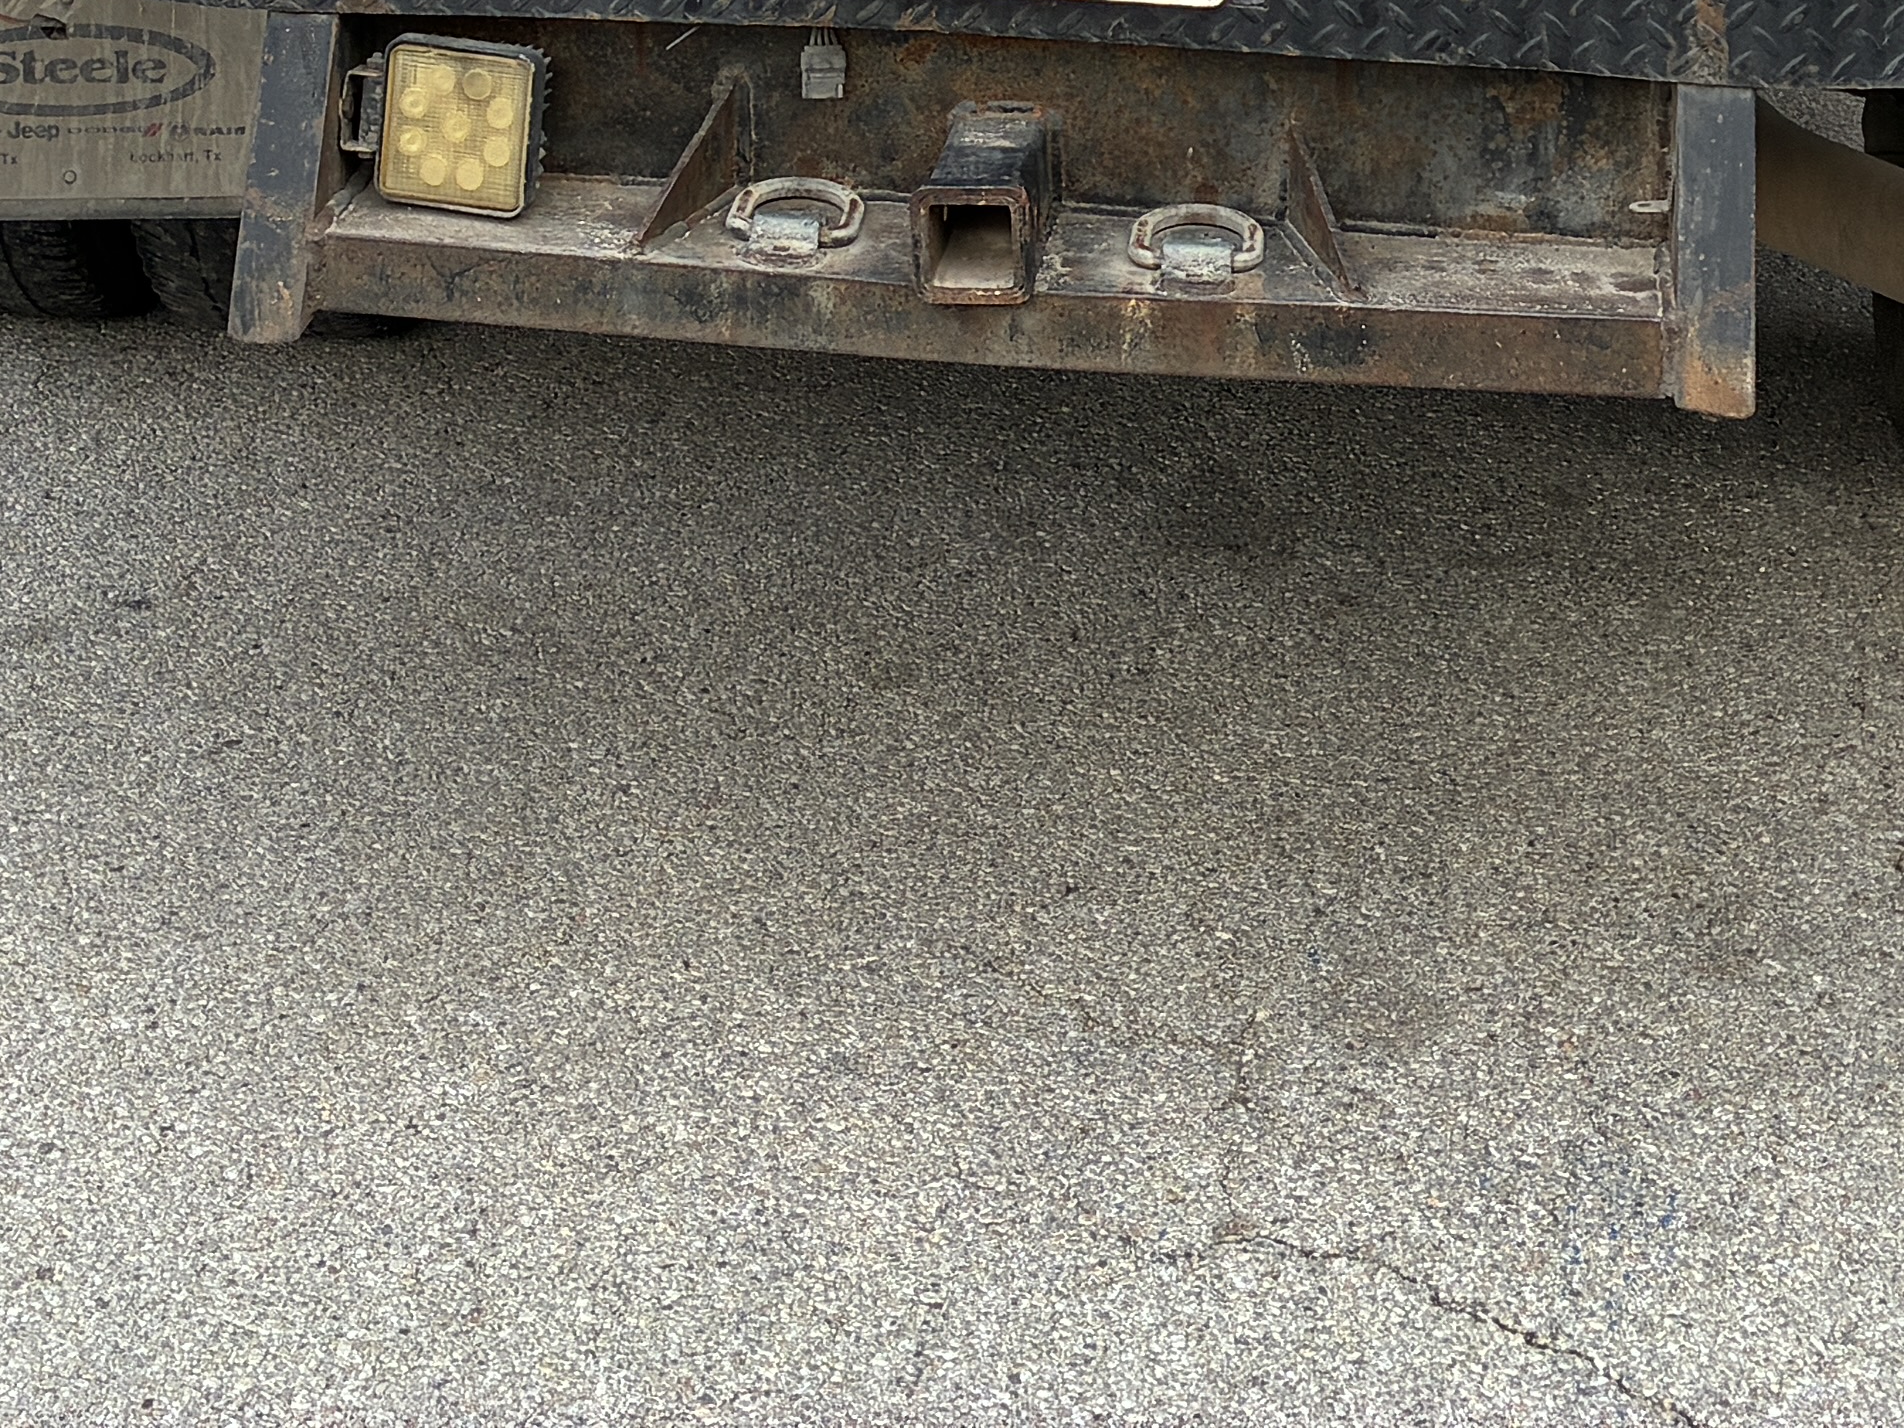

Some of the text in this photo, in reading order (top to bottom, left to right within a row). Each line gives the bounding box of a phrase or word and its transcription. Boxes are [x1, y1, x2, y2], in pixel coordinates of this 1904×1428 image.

[7, 120, 60, 142] Jeep
[0, 153, 19, 166] Tx
[203, 149, 222, 162] Tx
